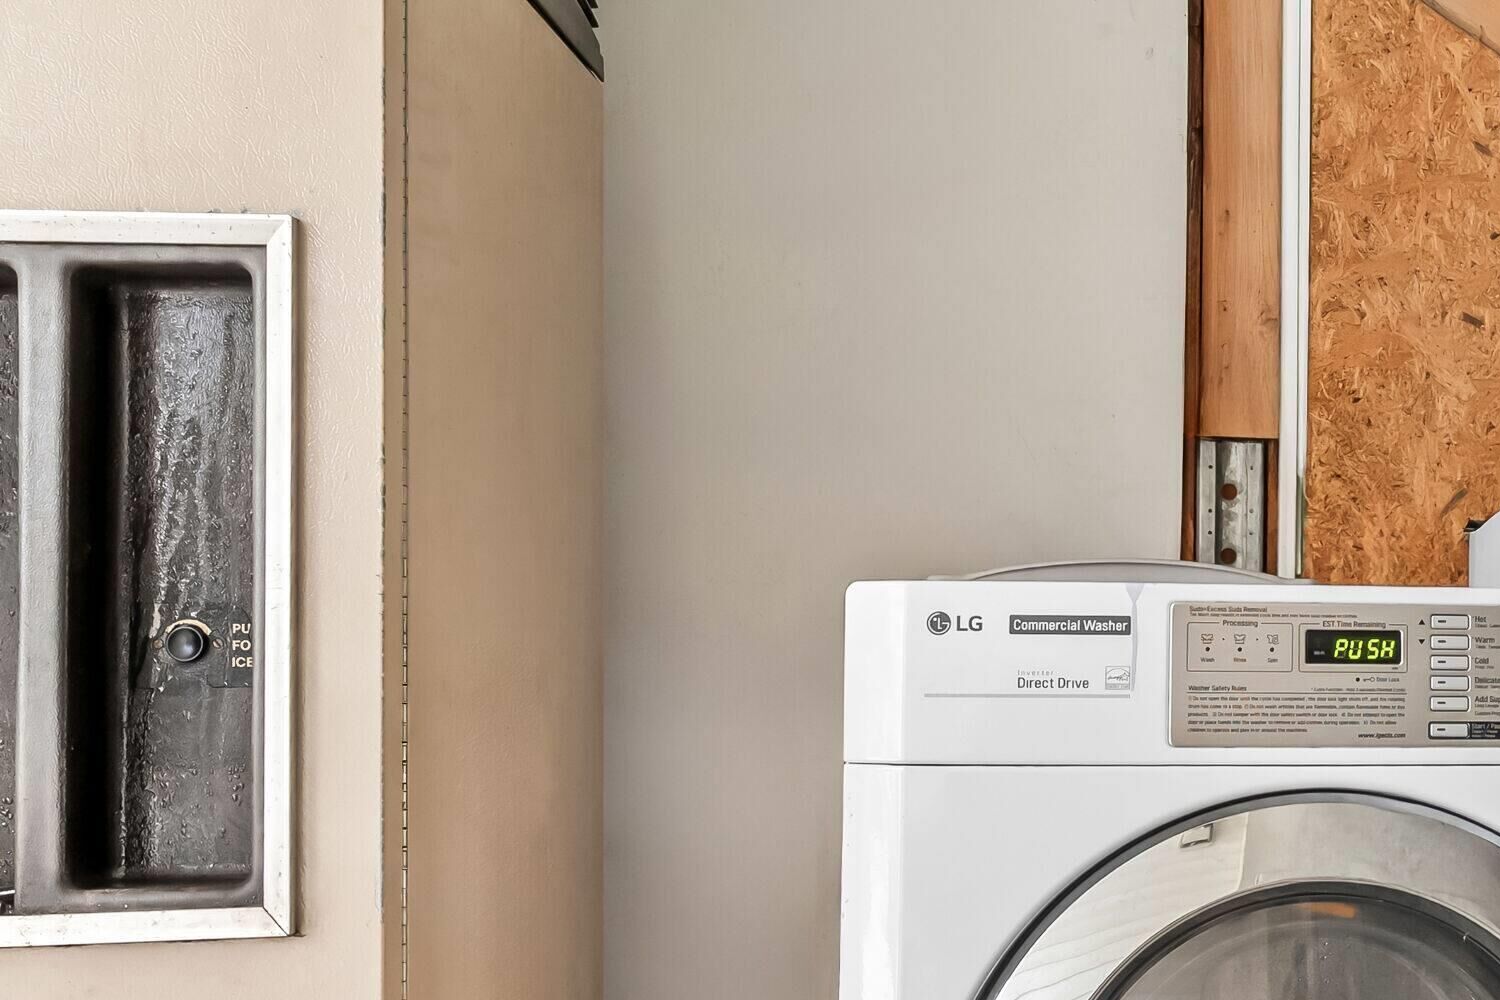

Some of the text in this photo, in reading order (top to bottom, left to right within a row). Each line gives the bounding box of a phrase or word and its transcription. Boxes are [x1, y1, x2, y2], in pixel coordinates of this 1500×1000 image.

[232, 623, 251, 634] PU
[956, 616, 1128, 632] LG Commercial Washer
[1222, 620, 1259, 628] Processing
[1353, 621, 1387, 630] Remaining
[232, 640, 252, 650] FO
[1474, 636, 1496, 644] Warm
[1333, 638, 1395, 660] PUSH
[1018, 677, 1089, 688] Direct Drive
